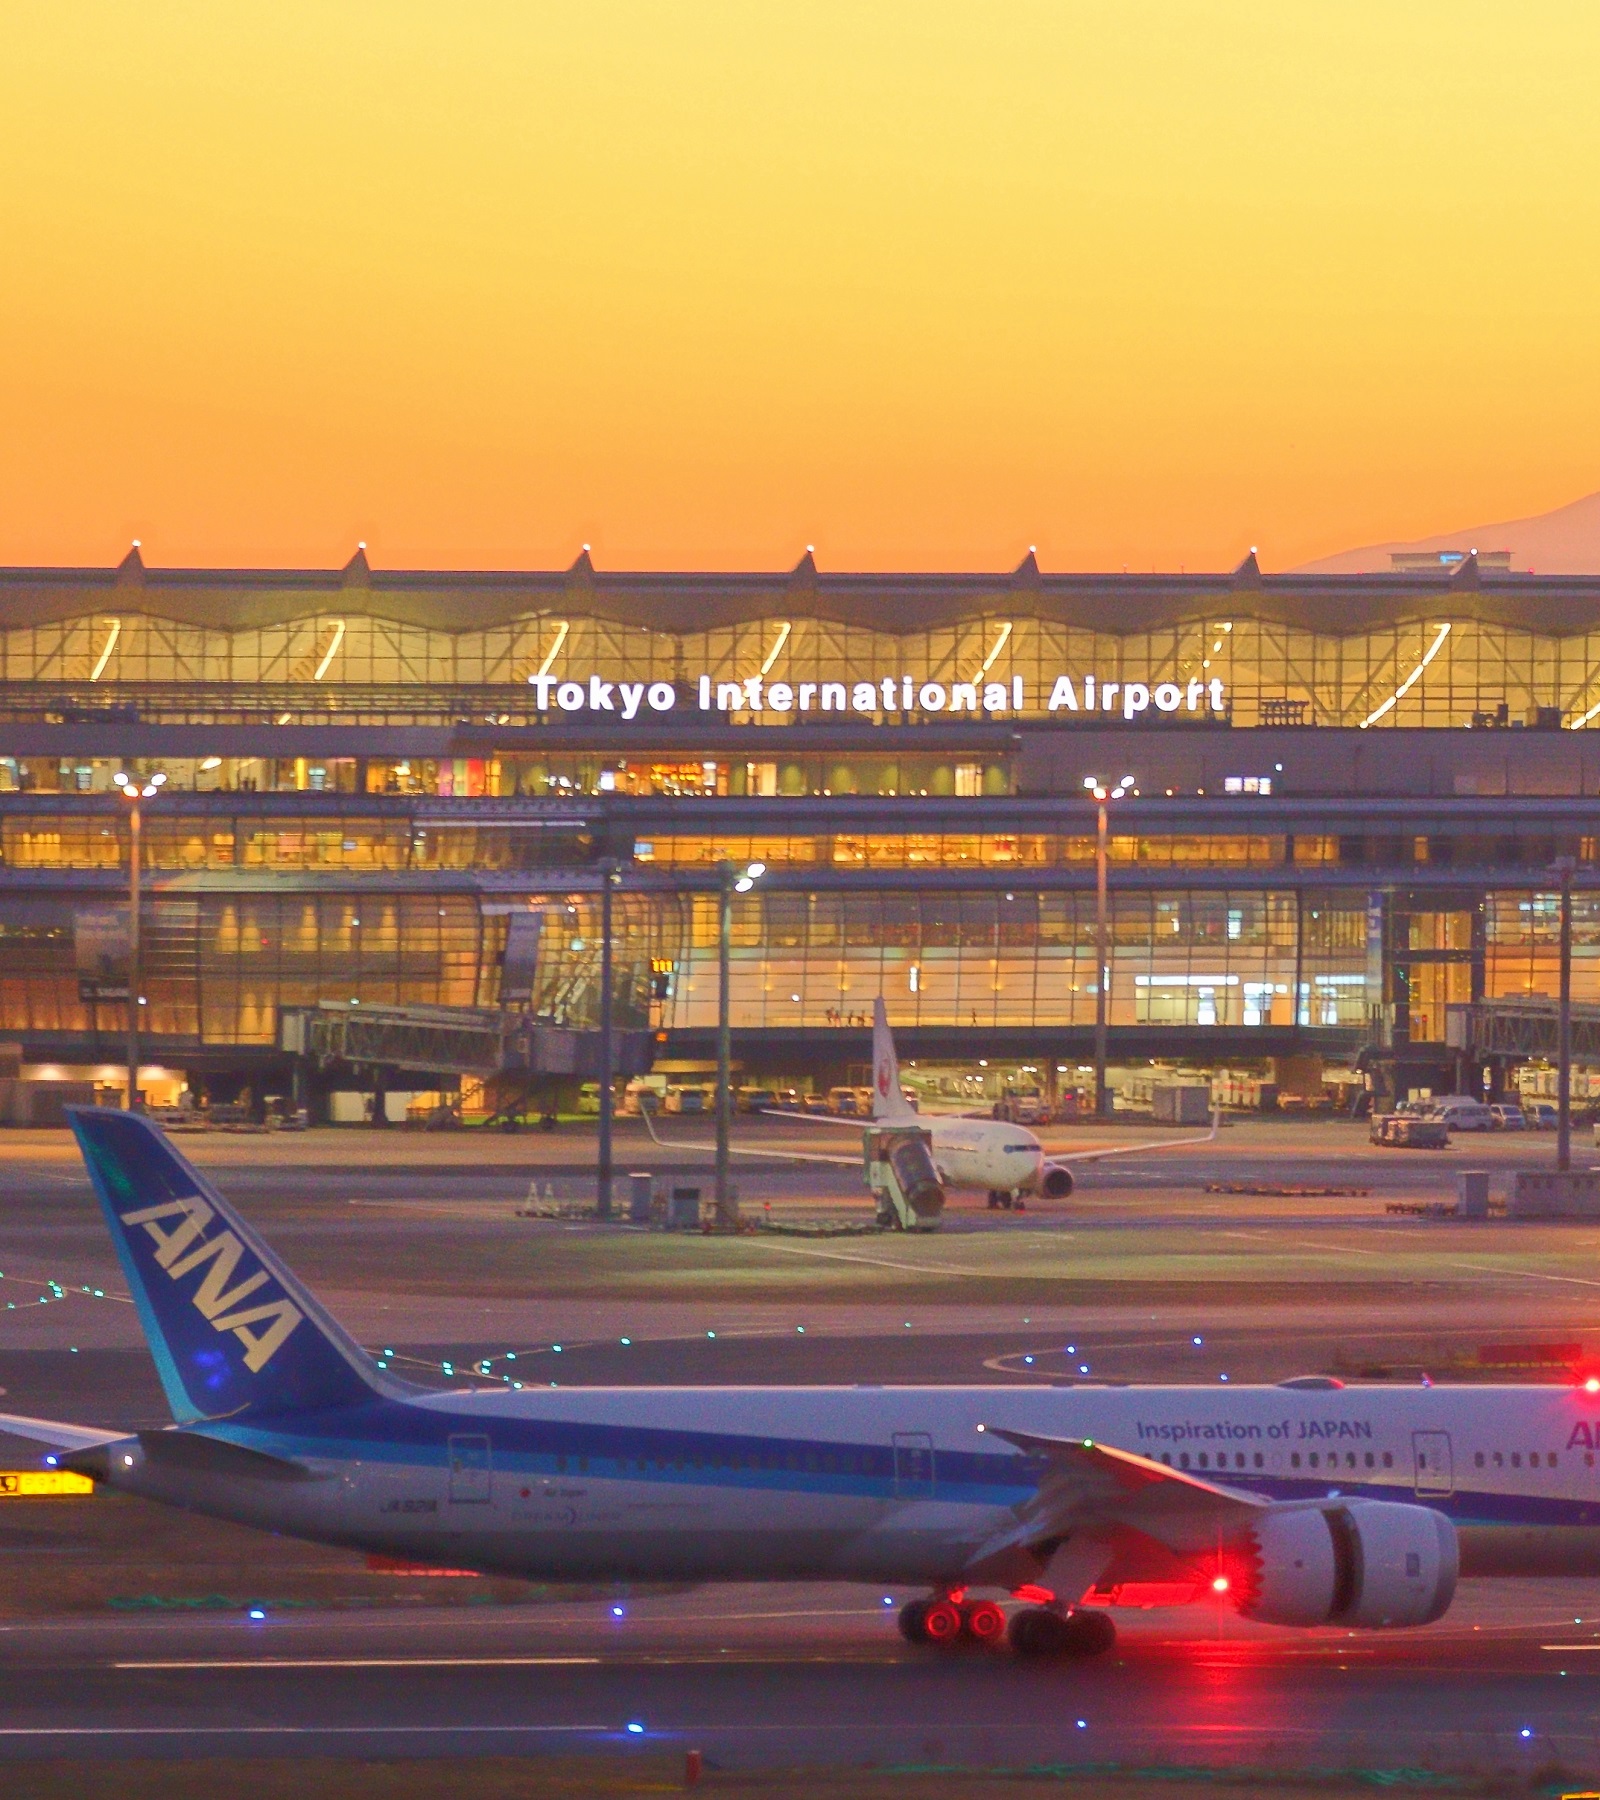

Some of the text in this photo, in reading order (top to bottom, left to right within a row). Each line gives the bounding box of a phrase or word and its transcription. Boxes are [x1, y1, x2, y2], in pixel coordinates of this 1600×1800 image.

[528, 675, 1225, 720] Tokyo International Airport
[120, 1196, 302, 1374] ANA
[1136, 1420, 1373, 1443] Inspiration of JAPAN
